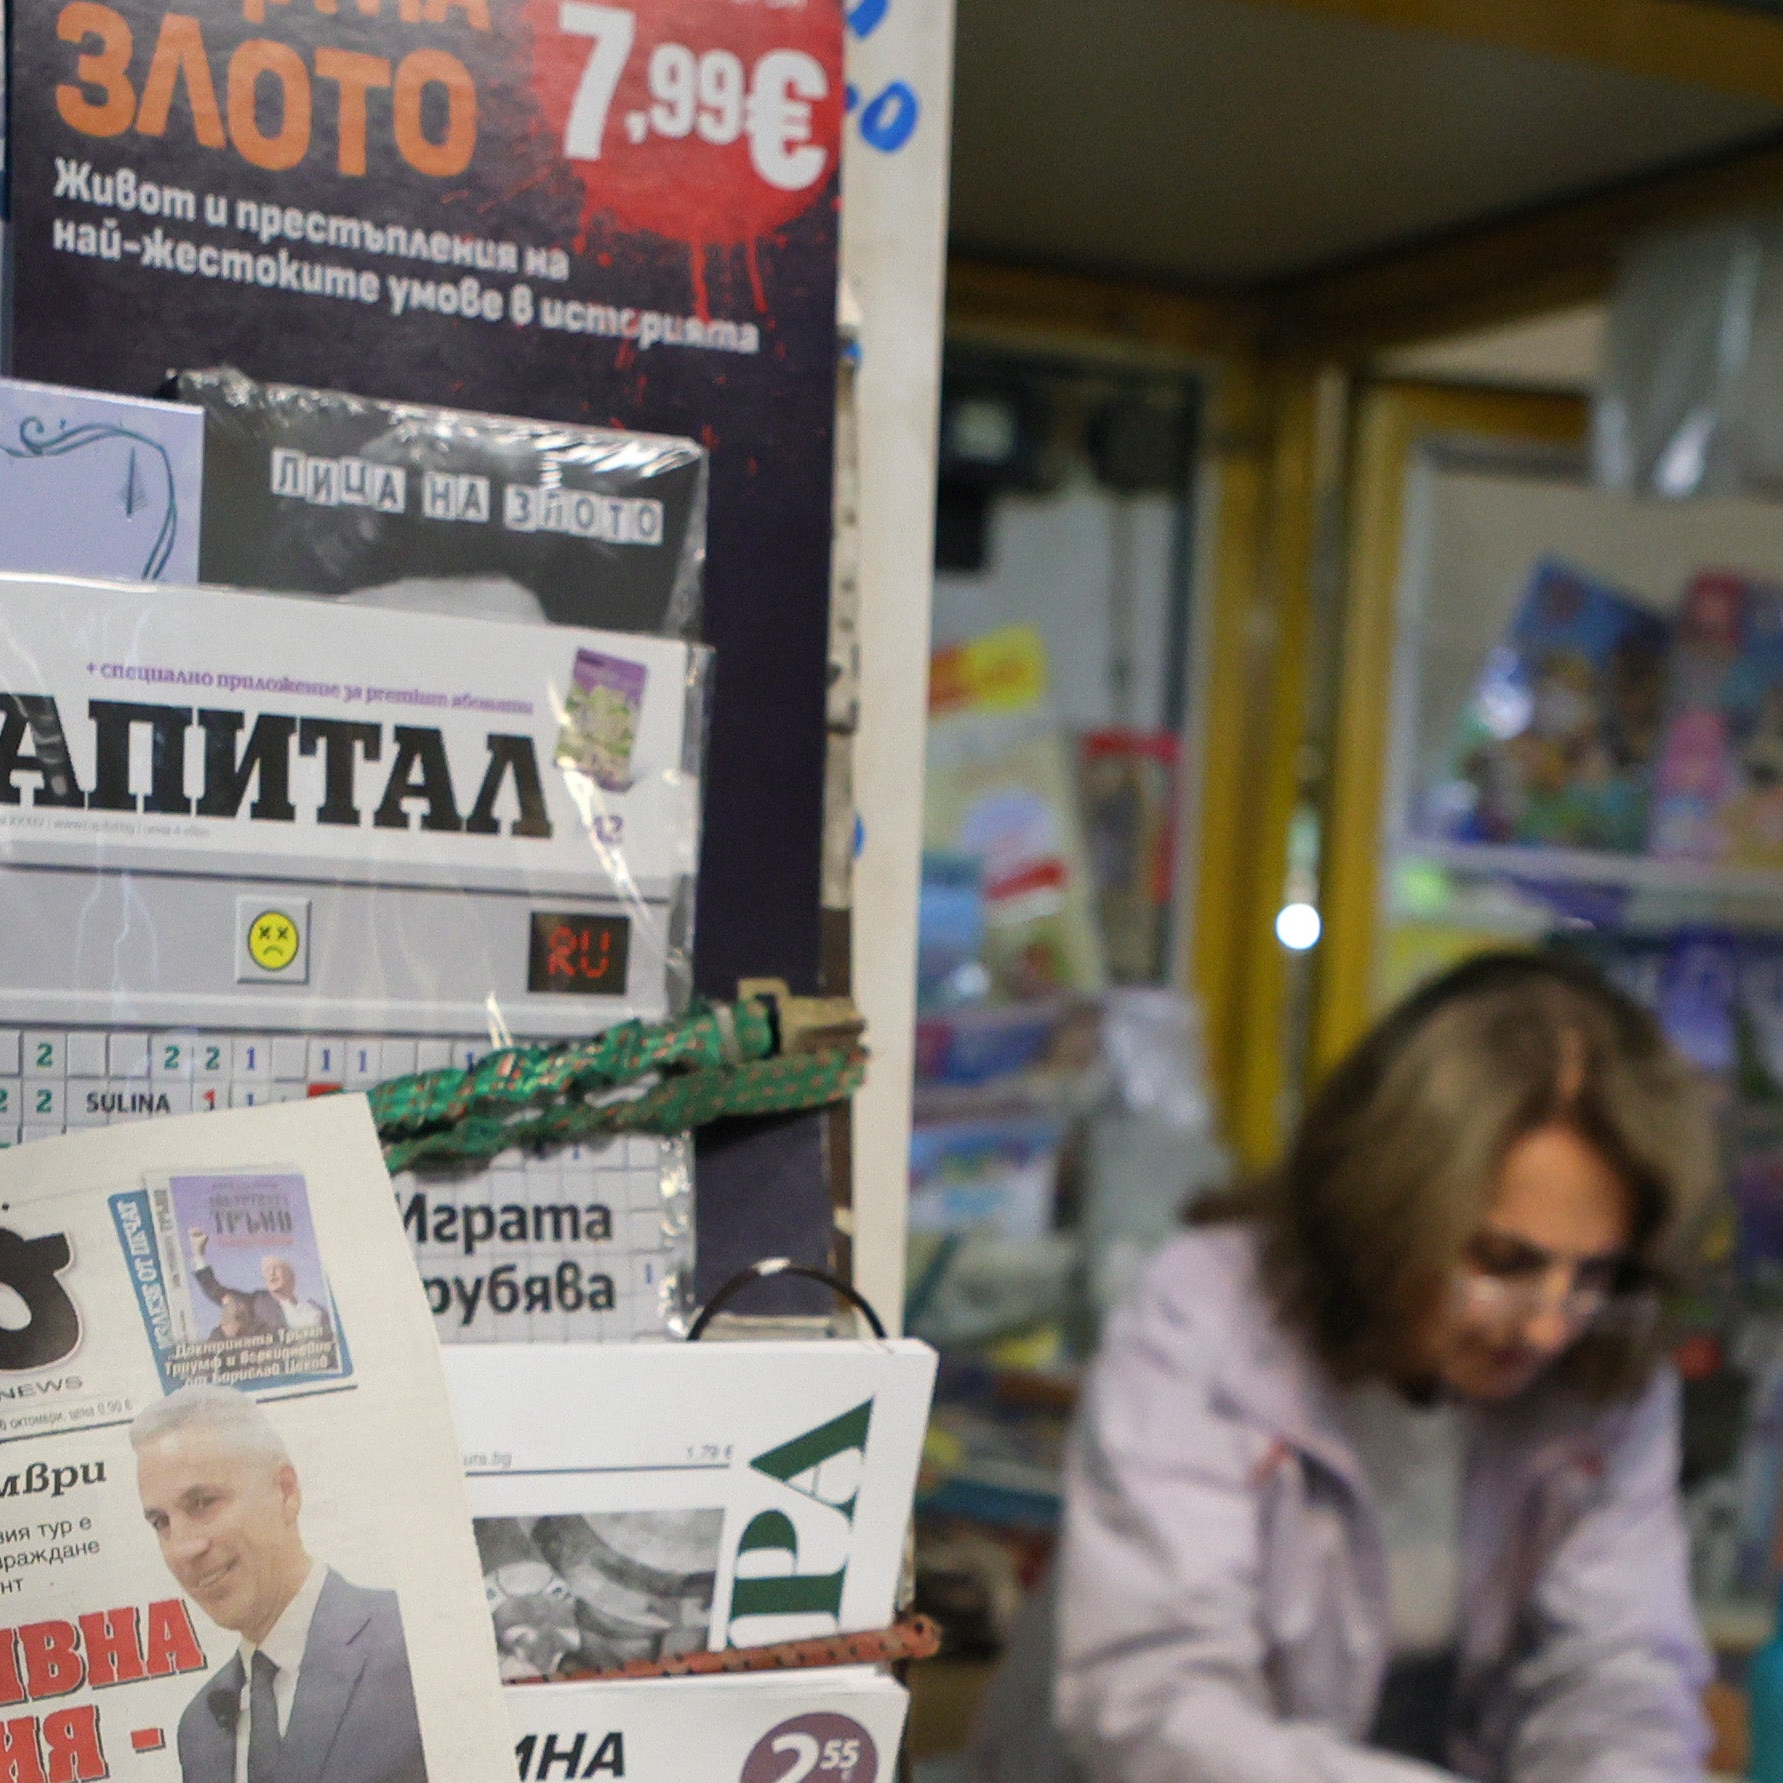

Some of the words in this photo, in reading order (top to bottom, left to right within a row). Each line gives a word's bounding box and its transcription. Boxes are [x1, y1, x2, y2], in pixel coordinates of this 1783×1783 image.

[54, 12, 479, 180] ЗЛОТО
[557, 0, 830, 191] 7,99€
[53, 156, 198, 223] Живот
[204, 193, 228, 226] и
[235, 199, 518, 279] престъпления
[524, 245, 571, 284] на
[51, 217, 381, 307] най-жестоките
[388, 278, 506, 326] умове
[510, 288, 534, 326] в
[540, 302, 760, 356] историята
[272, 449, 405, 512] ЛИЦА
[424, 470, 489, 522] НА
[505, 487, 663, 545] ЗЛОТО
[546, 925, 612, 977] RU
[85, 1089, 172, 1117] SULINA
[37, 1518, 75, 1542] тур
[78, 1516, 92, 1532] е
